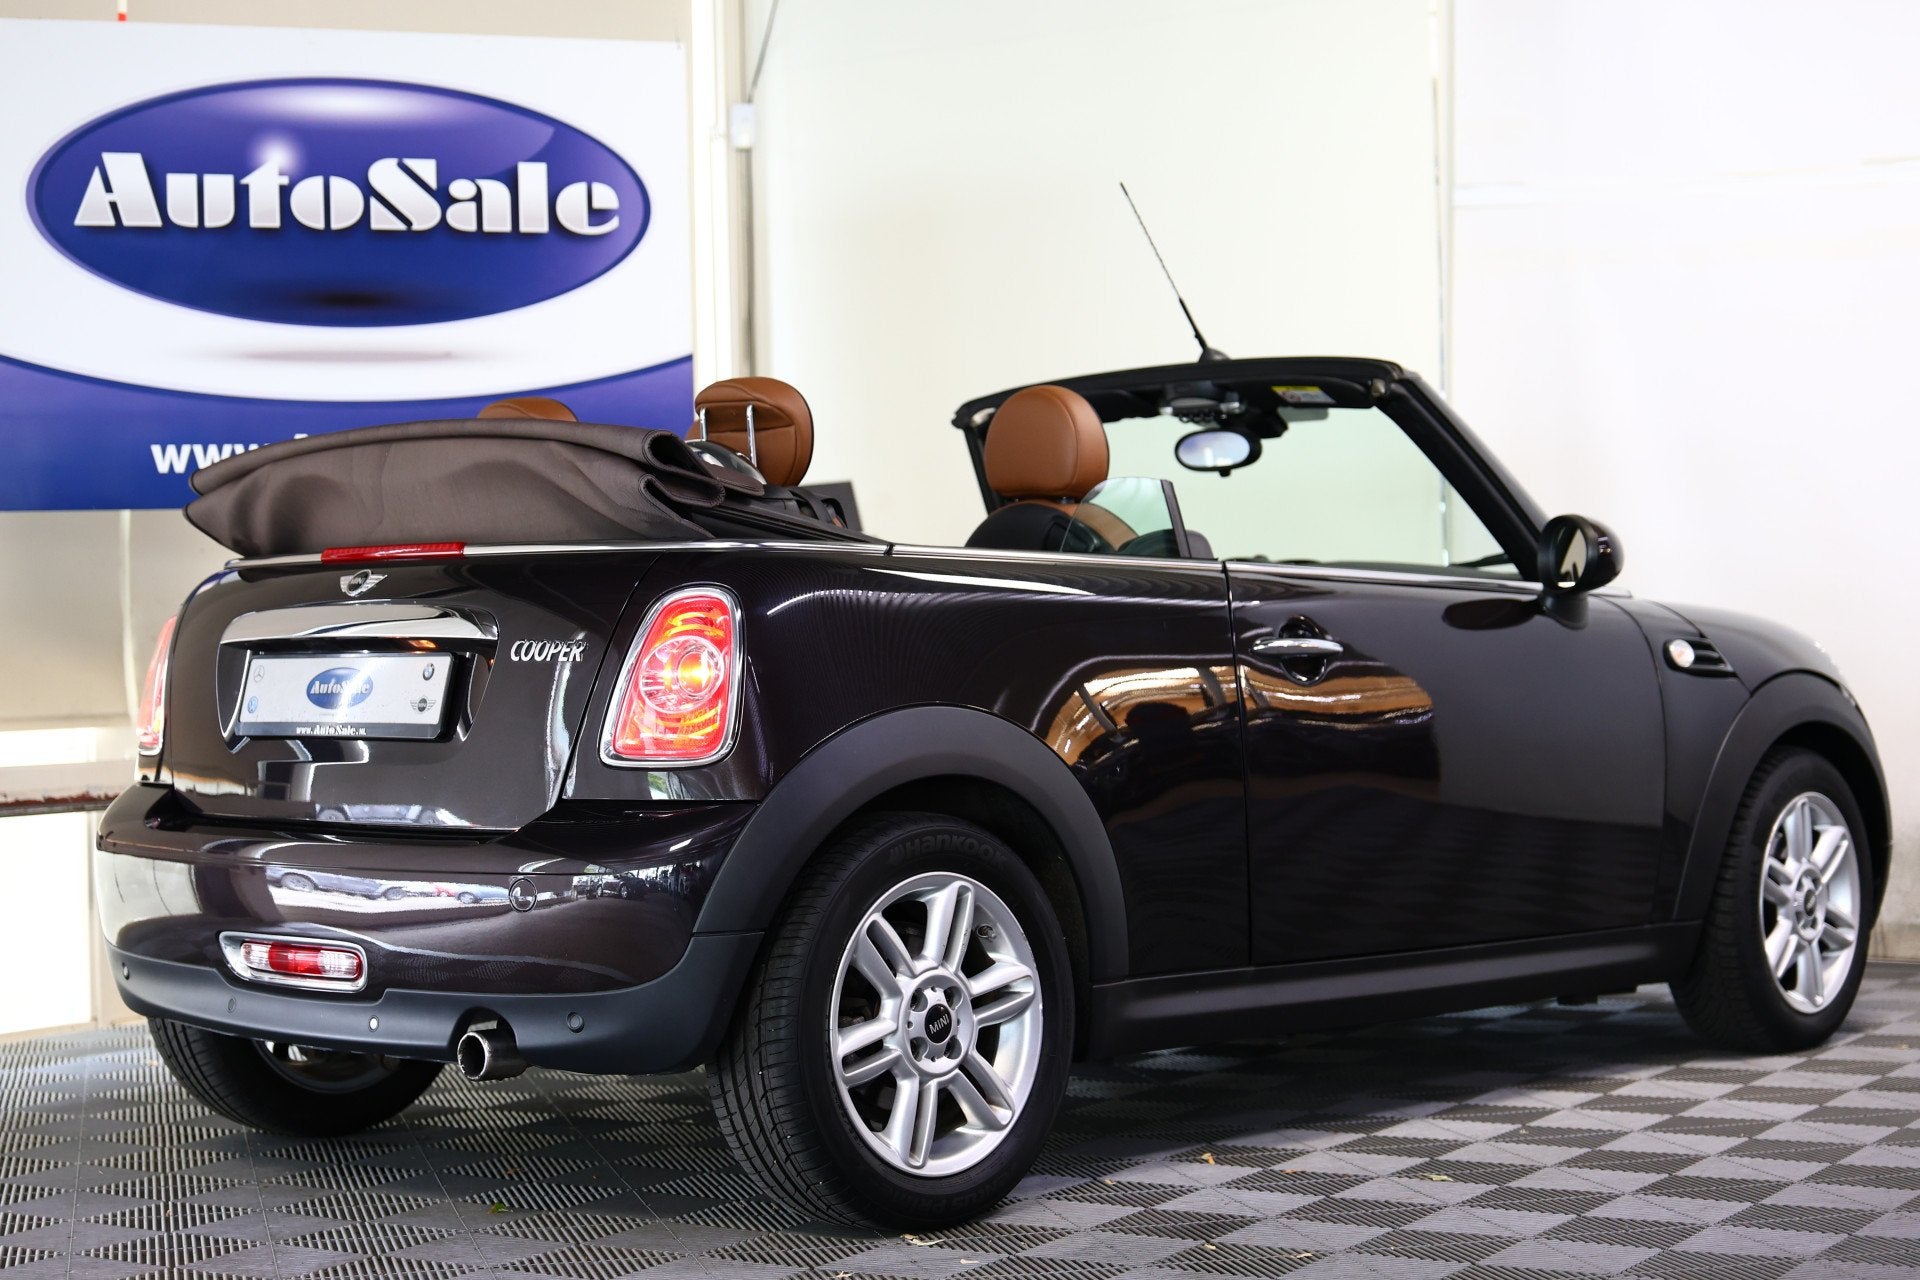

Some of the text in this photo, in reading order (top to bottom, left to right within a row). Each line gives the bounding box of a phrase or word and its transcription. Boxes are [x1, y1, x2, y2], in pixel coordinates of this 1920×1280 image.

[73, 151, 621, 236] AutoSale
[510, 639, 587, 662] COOPER
[310, 678, 370, 695] AutoSe
[929, 1013, 950, 1035] MINI
